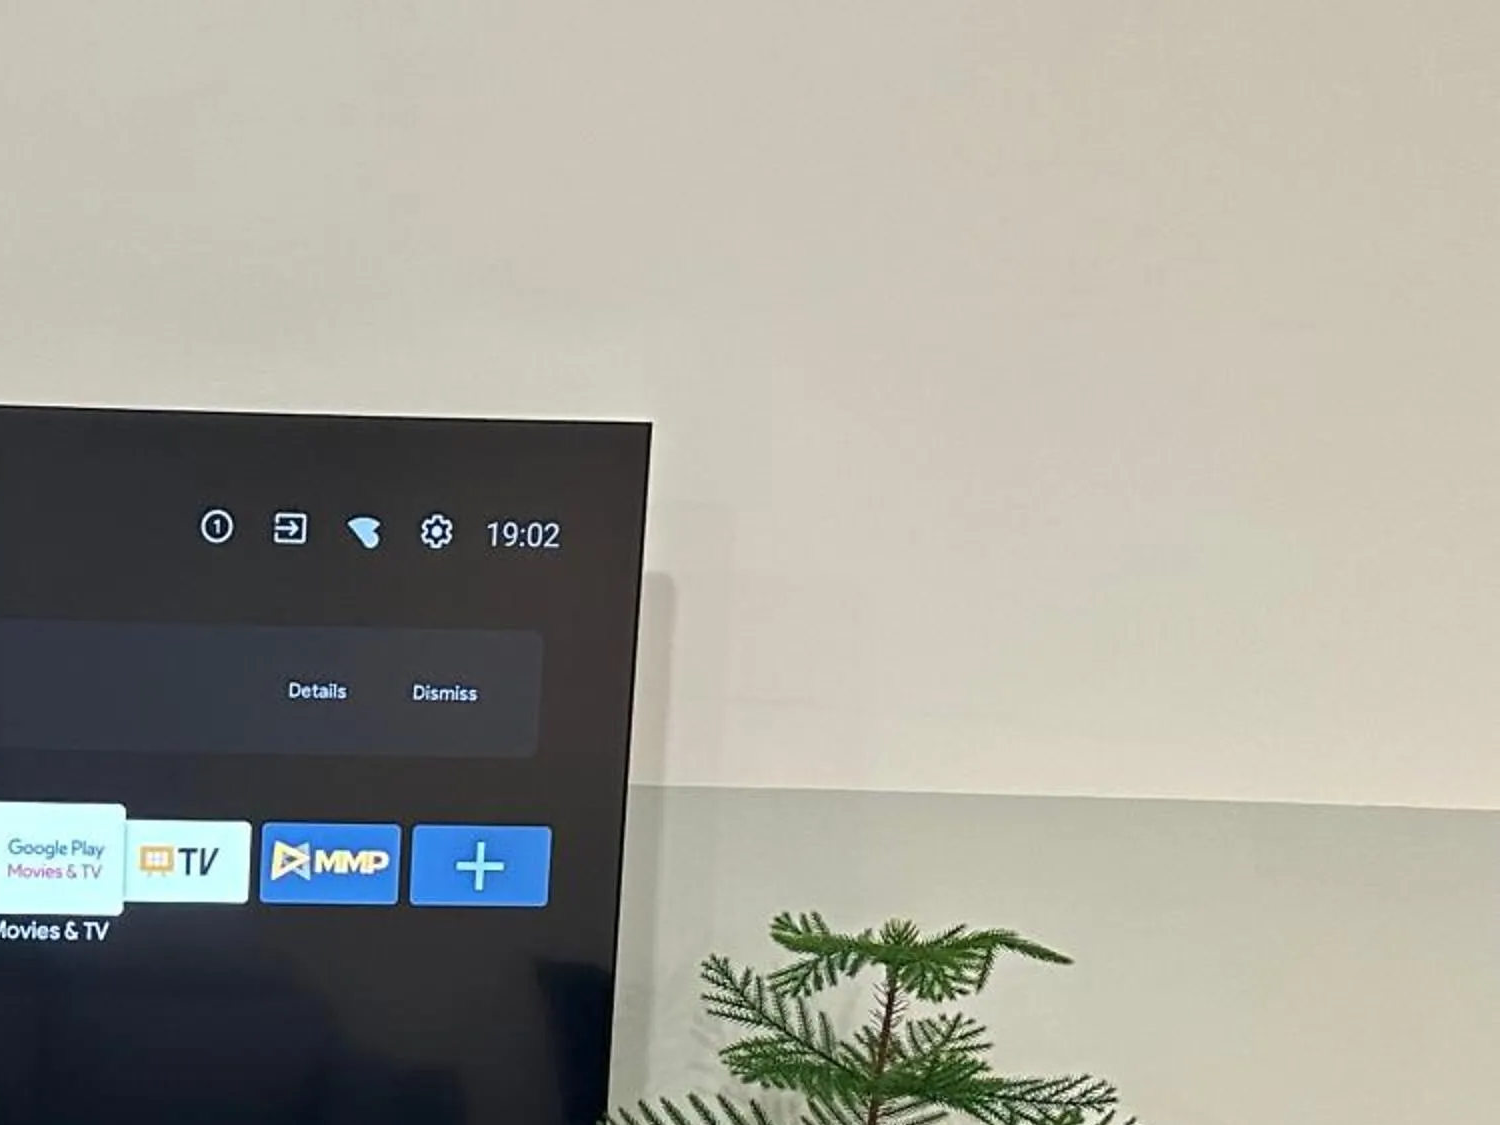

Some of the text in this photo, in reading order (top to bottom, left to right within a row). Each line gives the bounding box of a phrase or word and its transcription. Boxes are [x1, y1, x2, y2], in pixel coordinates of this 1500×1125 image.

[488, 522, 559, 547] 19:02
[289, 682, 346, 698] Details
[413, 685, 477, 700] Dismiss
[8, 838, 104, 860] Google Play
[8, 864, 102, 879] Movies & TV
[178, 848, 218, 875] TV
[315, 850, 389, 874] MMP
[64, 921, 78, 940] &
[83, 922, 109, 940] TV
